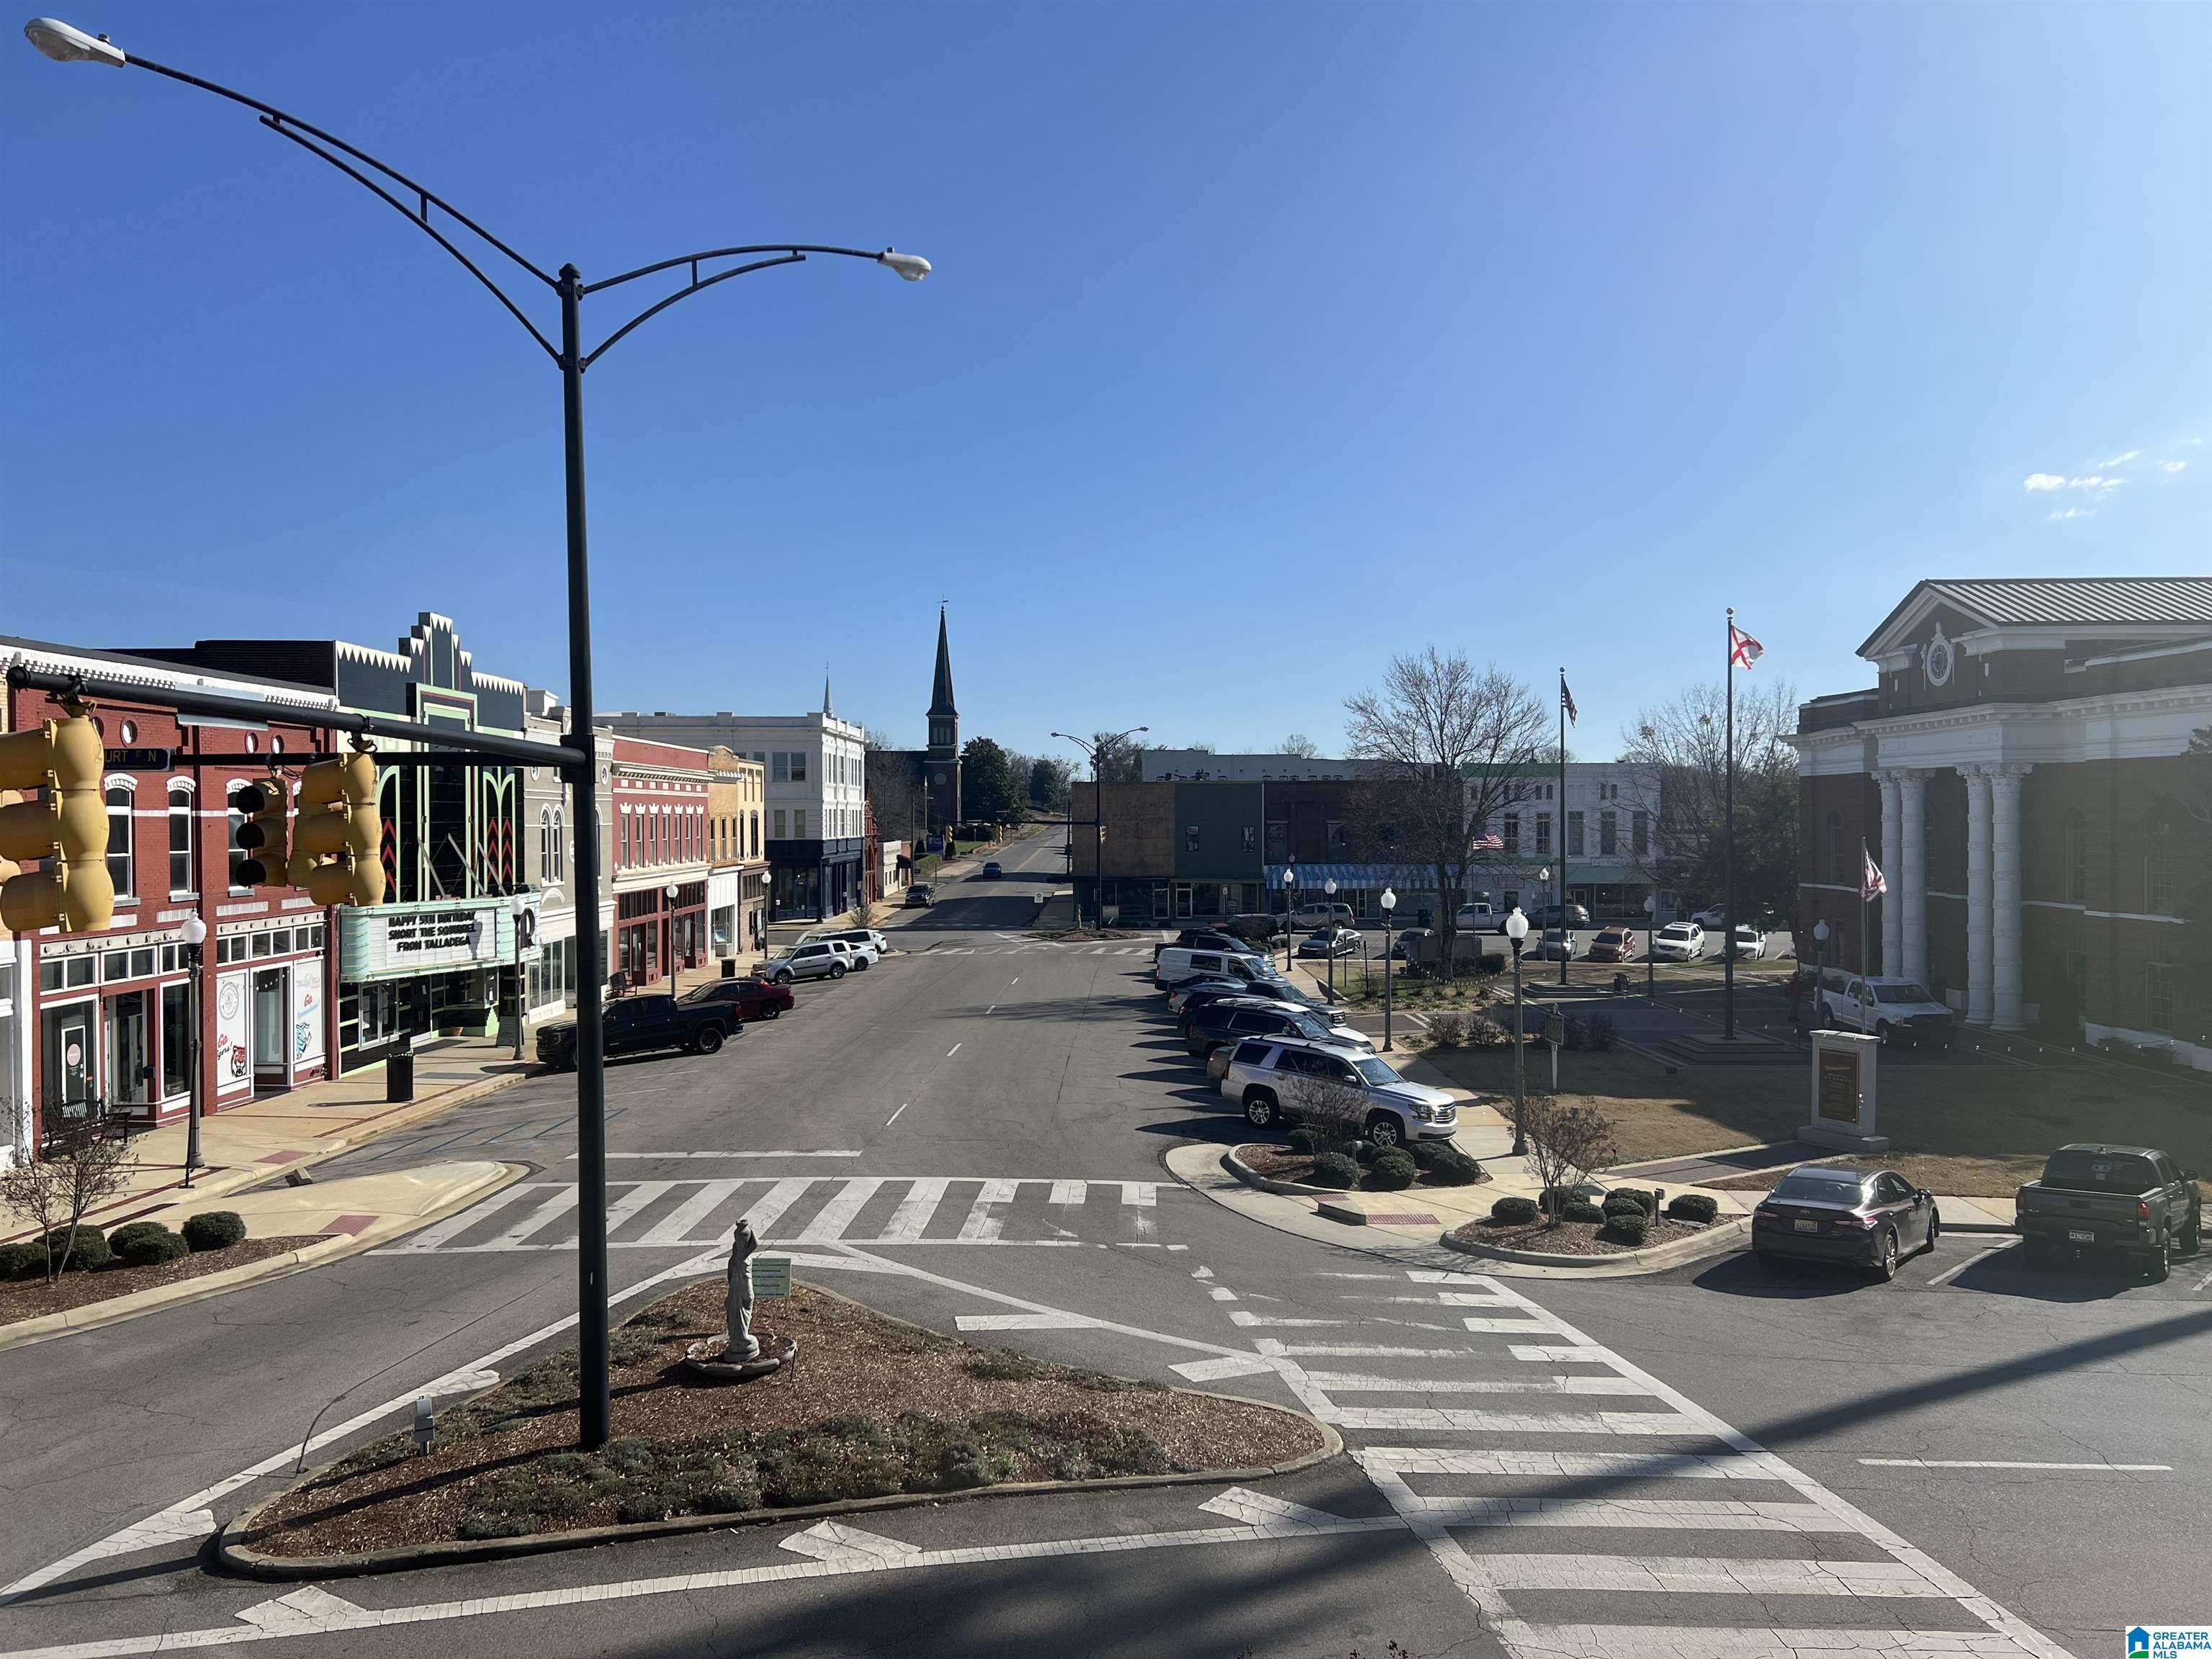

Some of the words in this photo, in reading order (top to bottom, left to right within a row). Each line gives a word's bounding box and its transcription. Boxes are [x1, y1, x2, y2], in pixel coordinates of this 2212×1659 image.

[105, 750, 129, 763] URT
[148, 750, 156, 763] N
[389, 915, 418, 927] HAPPY
[419, 914, 436, 925] 5TH
[437, 911, 476, 924] BIRTHDAY
[419, 926, 436, 938] THE
[437, 923, 475, 936] SQUIRREL
[397, 939, 422, 952] FROM
[424, 936, 471, 950] TALLADEGA
